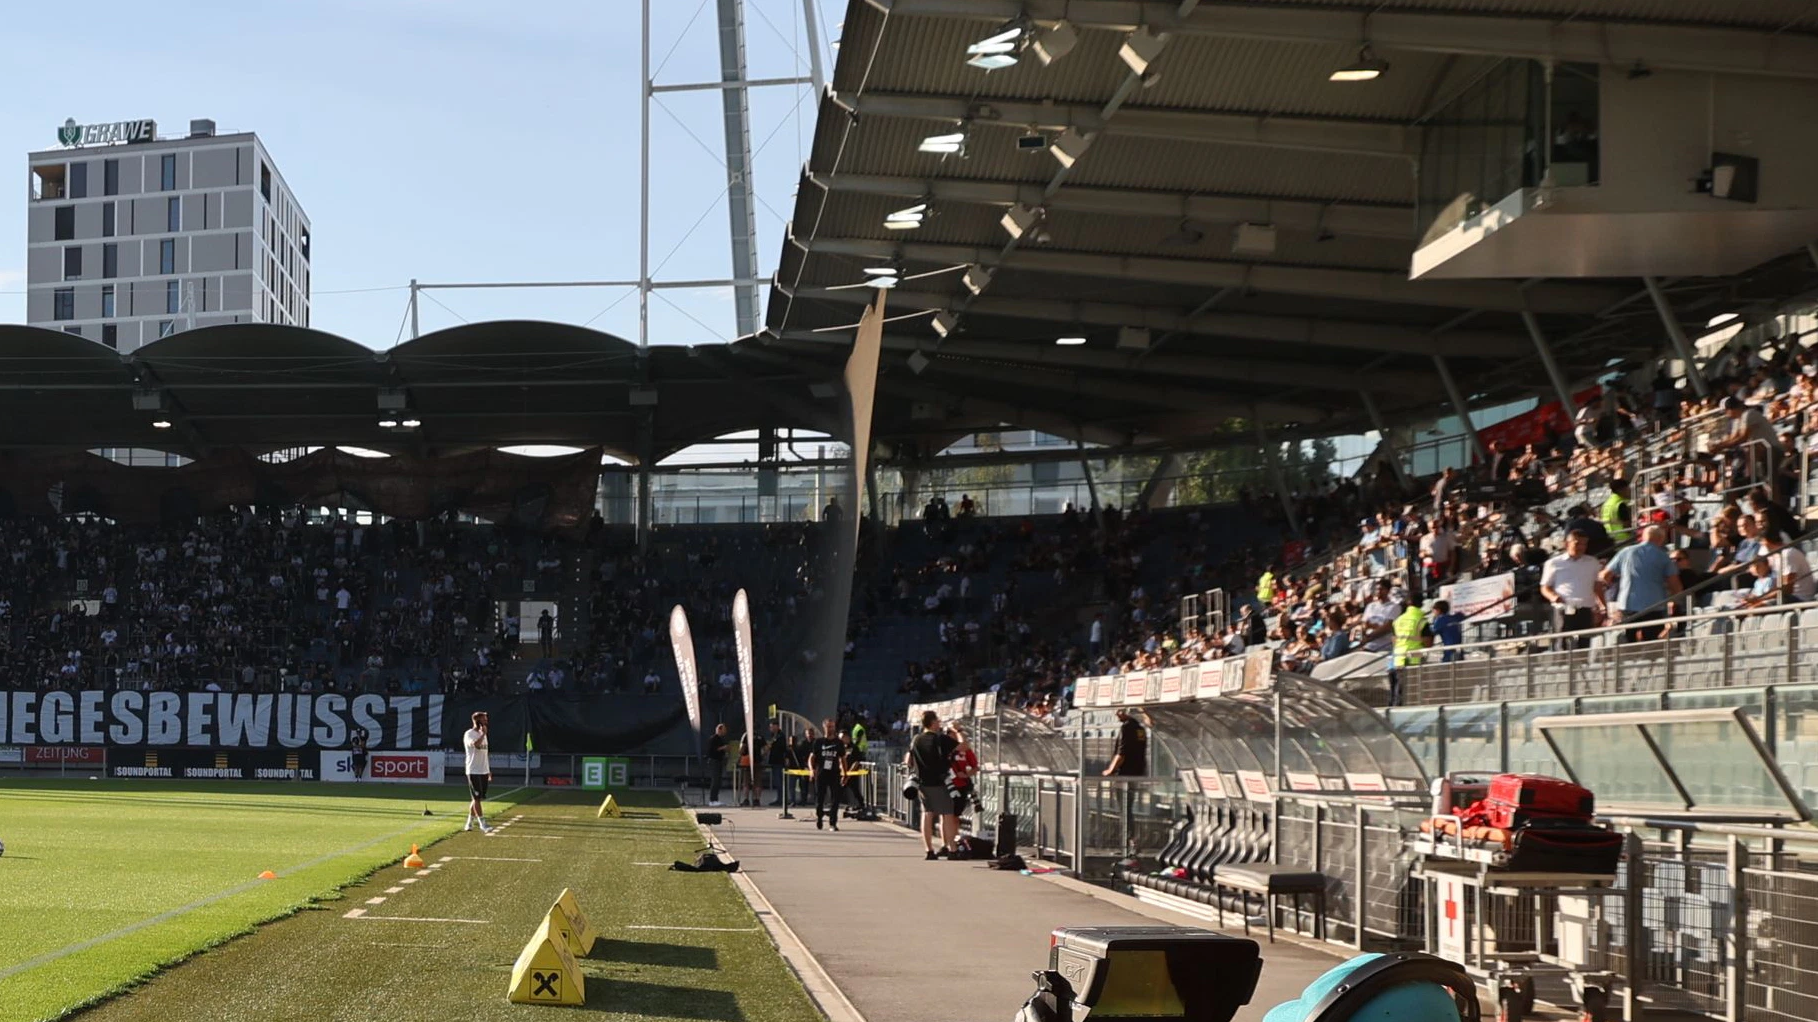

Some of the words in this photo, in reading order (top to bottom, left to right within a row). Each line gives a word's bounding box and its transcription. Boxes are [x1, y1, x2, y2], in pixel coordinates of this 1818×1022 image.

[84, 119, 153, 144] GRAWE
[35, 746, 89, 759] ZEITUNG
[116, 766, 172, 777] SOUNDPORTAL
[336, 758, 355, 773] sk
[374, 758, 425, 775] sport
[186, 768, 242, 778] SOUNDPORTAL
[257, 768, 313, 779] SOUNDPOTAL
